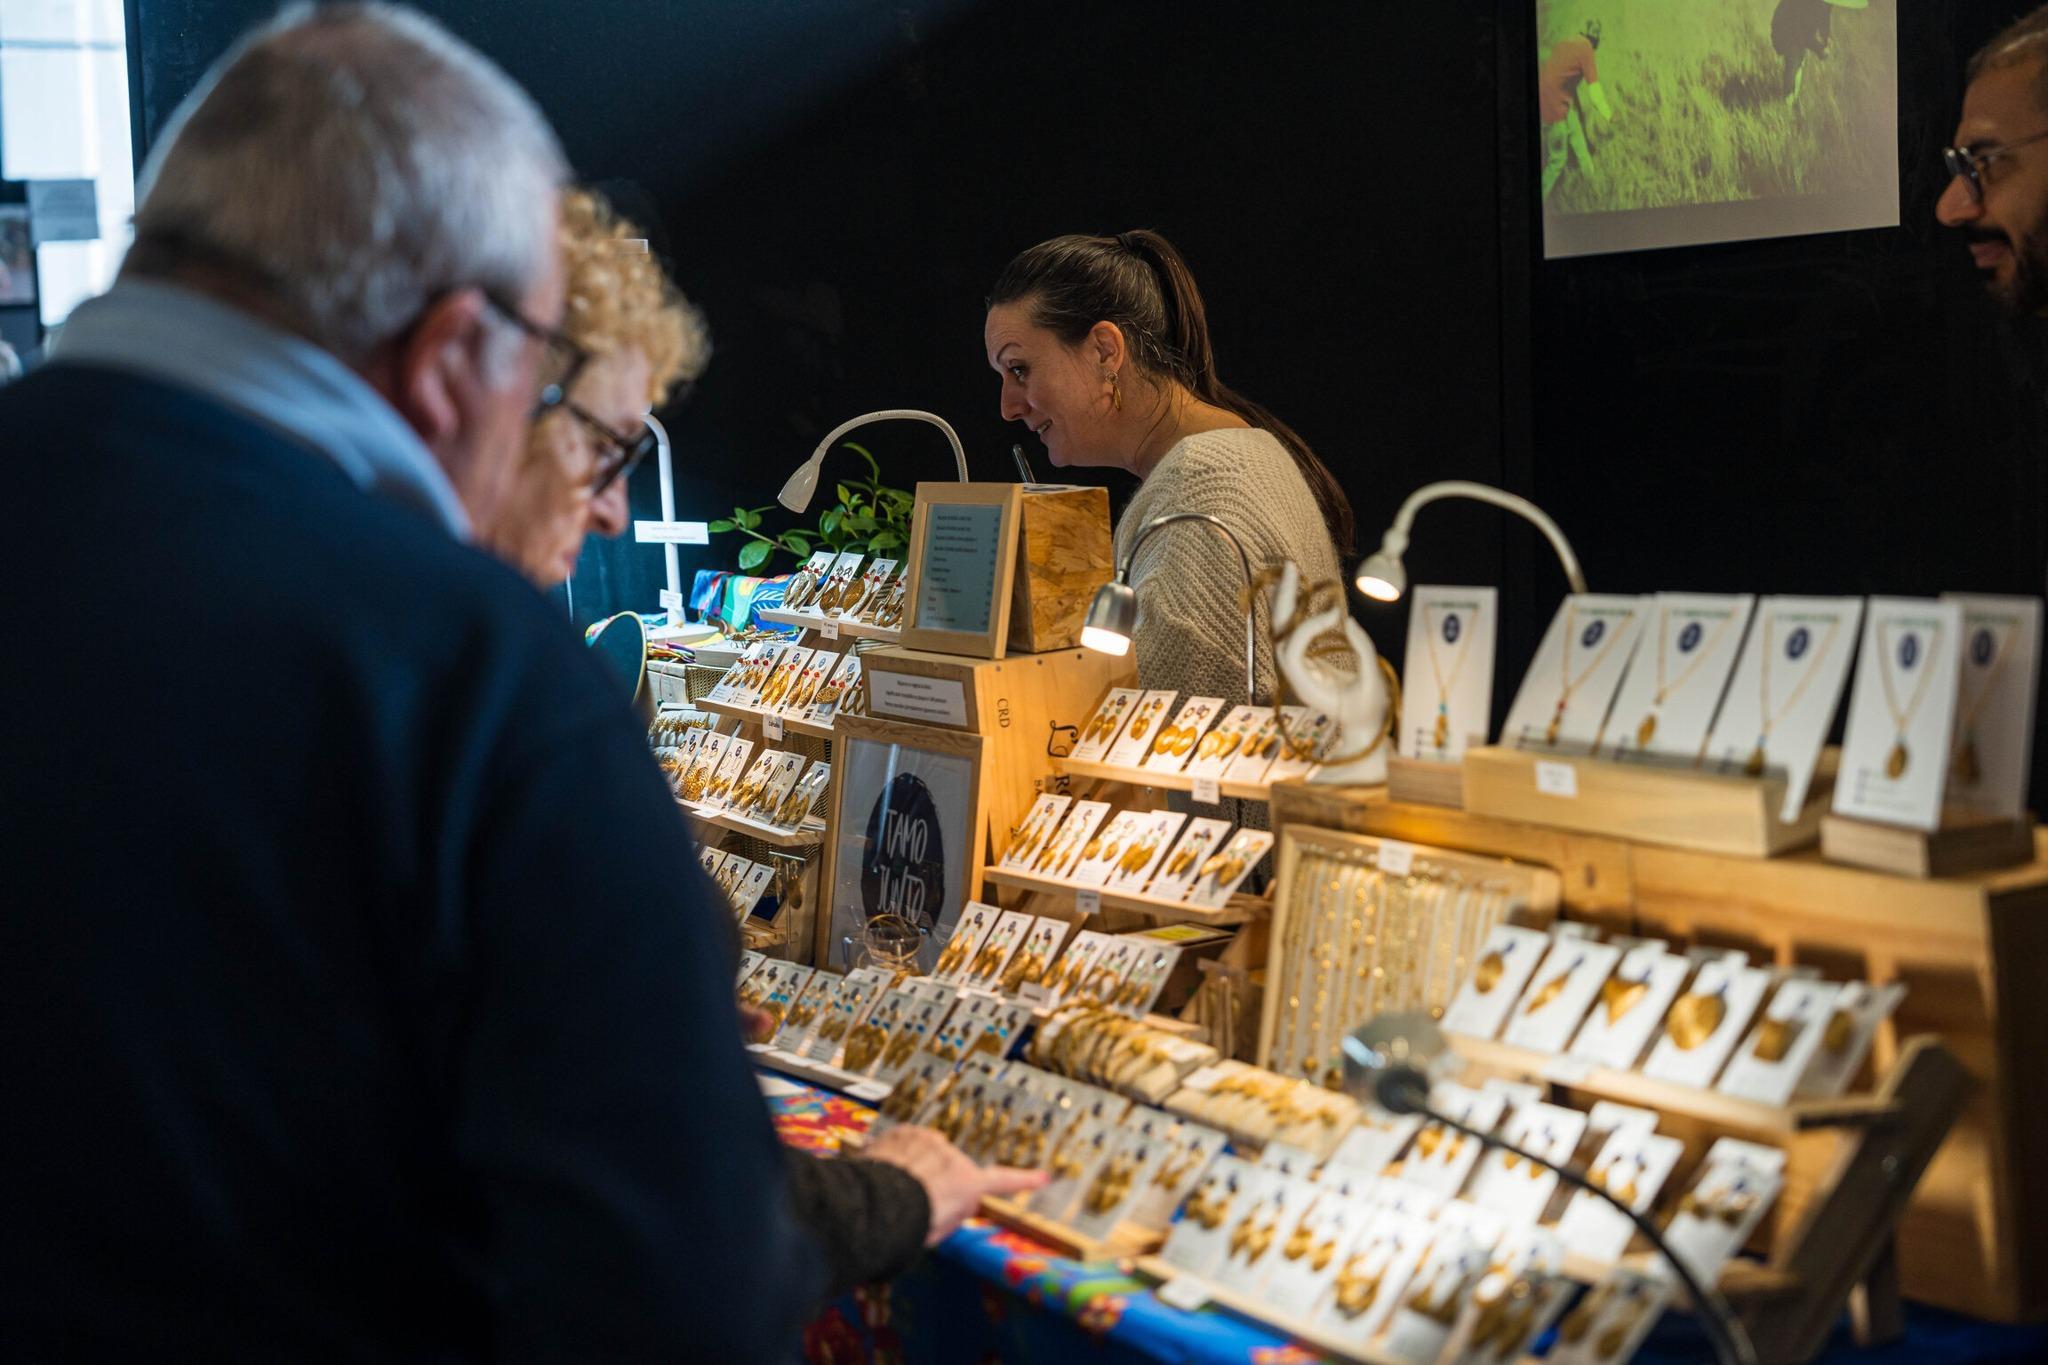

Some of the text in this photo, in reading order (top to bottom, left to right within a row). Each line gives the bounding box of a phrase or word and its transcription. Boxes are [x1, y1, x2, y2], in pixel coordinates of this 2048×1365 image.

[997, 698, 1010, 728] CRD
[886, 808, 928, 865] TAMO
[877, 865, 926, 925] JUNTO
